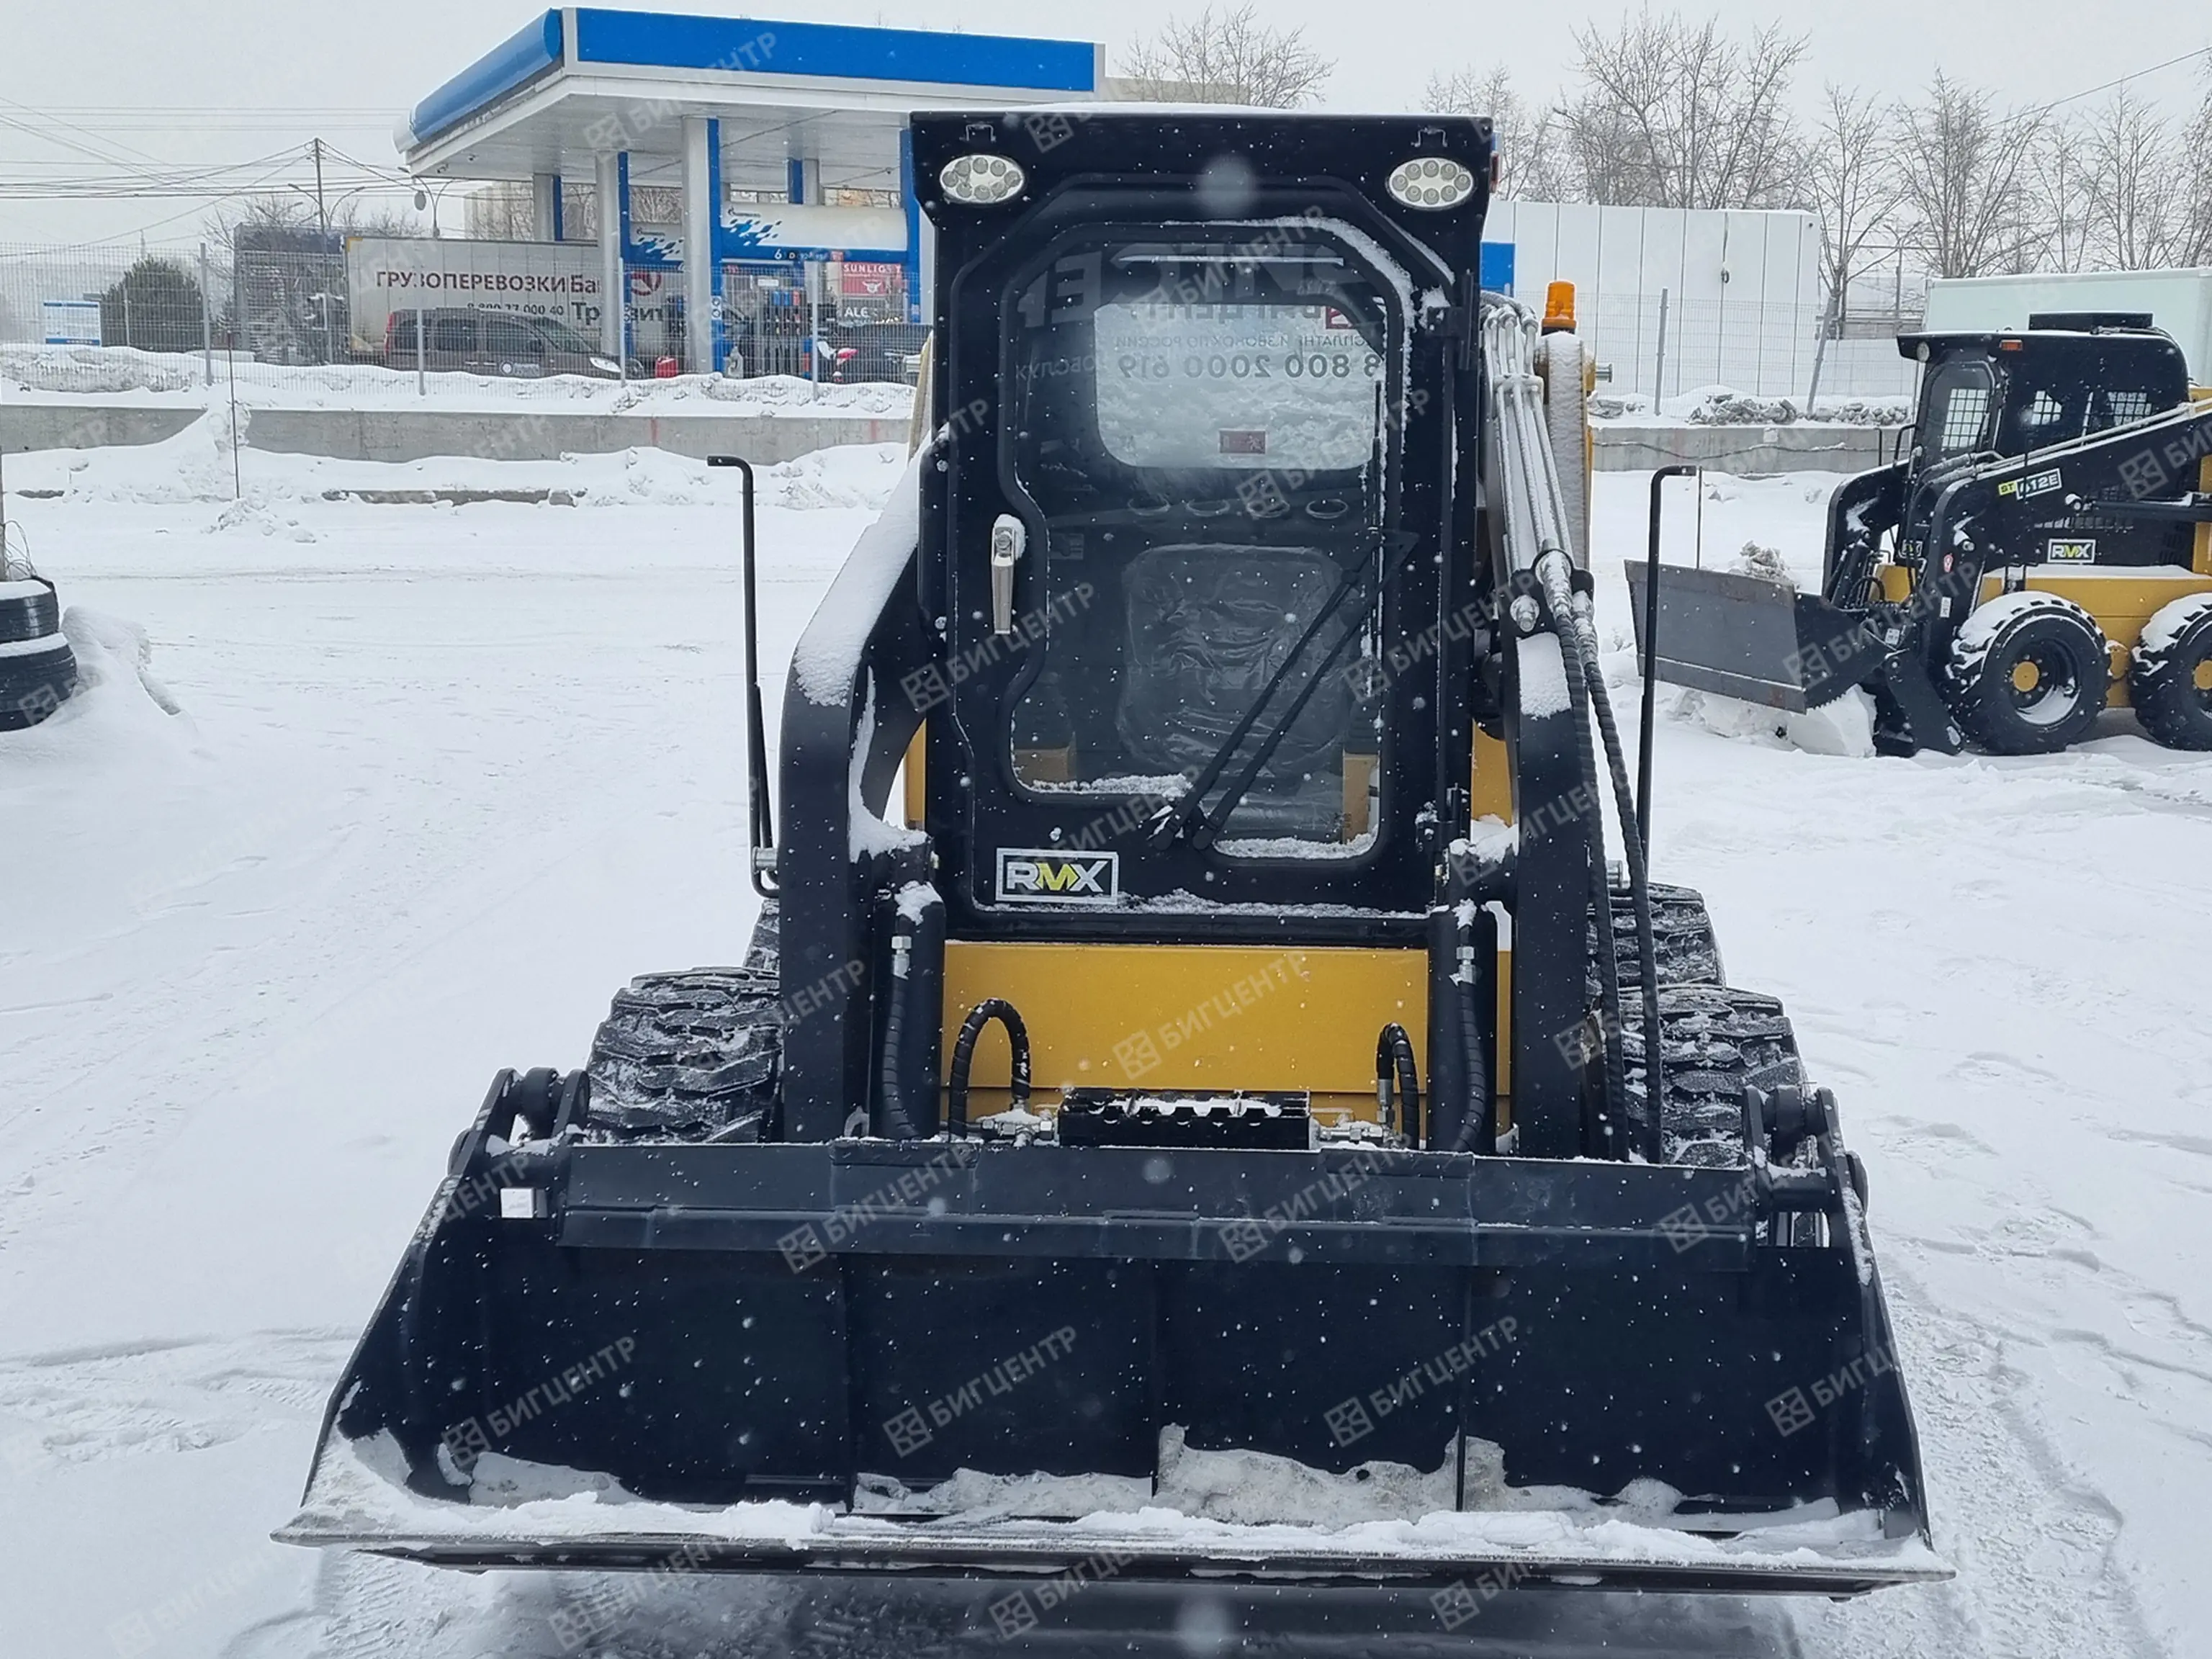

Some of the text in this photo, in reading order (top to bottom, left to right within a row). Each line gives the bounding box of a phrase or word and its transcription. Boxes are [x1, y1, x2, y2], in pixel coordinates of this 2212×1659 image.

[377, 271, 566, 293] ГРУЗОПЕРЕВОЗКИ
[2052, 544, 2091, 558] RMX
[1006, 860, 1109, 893] RMX
